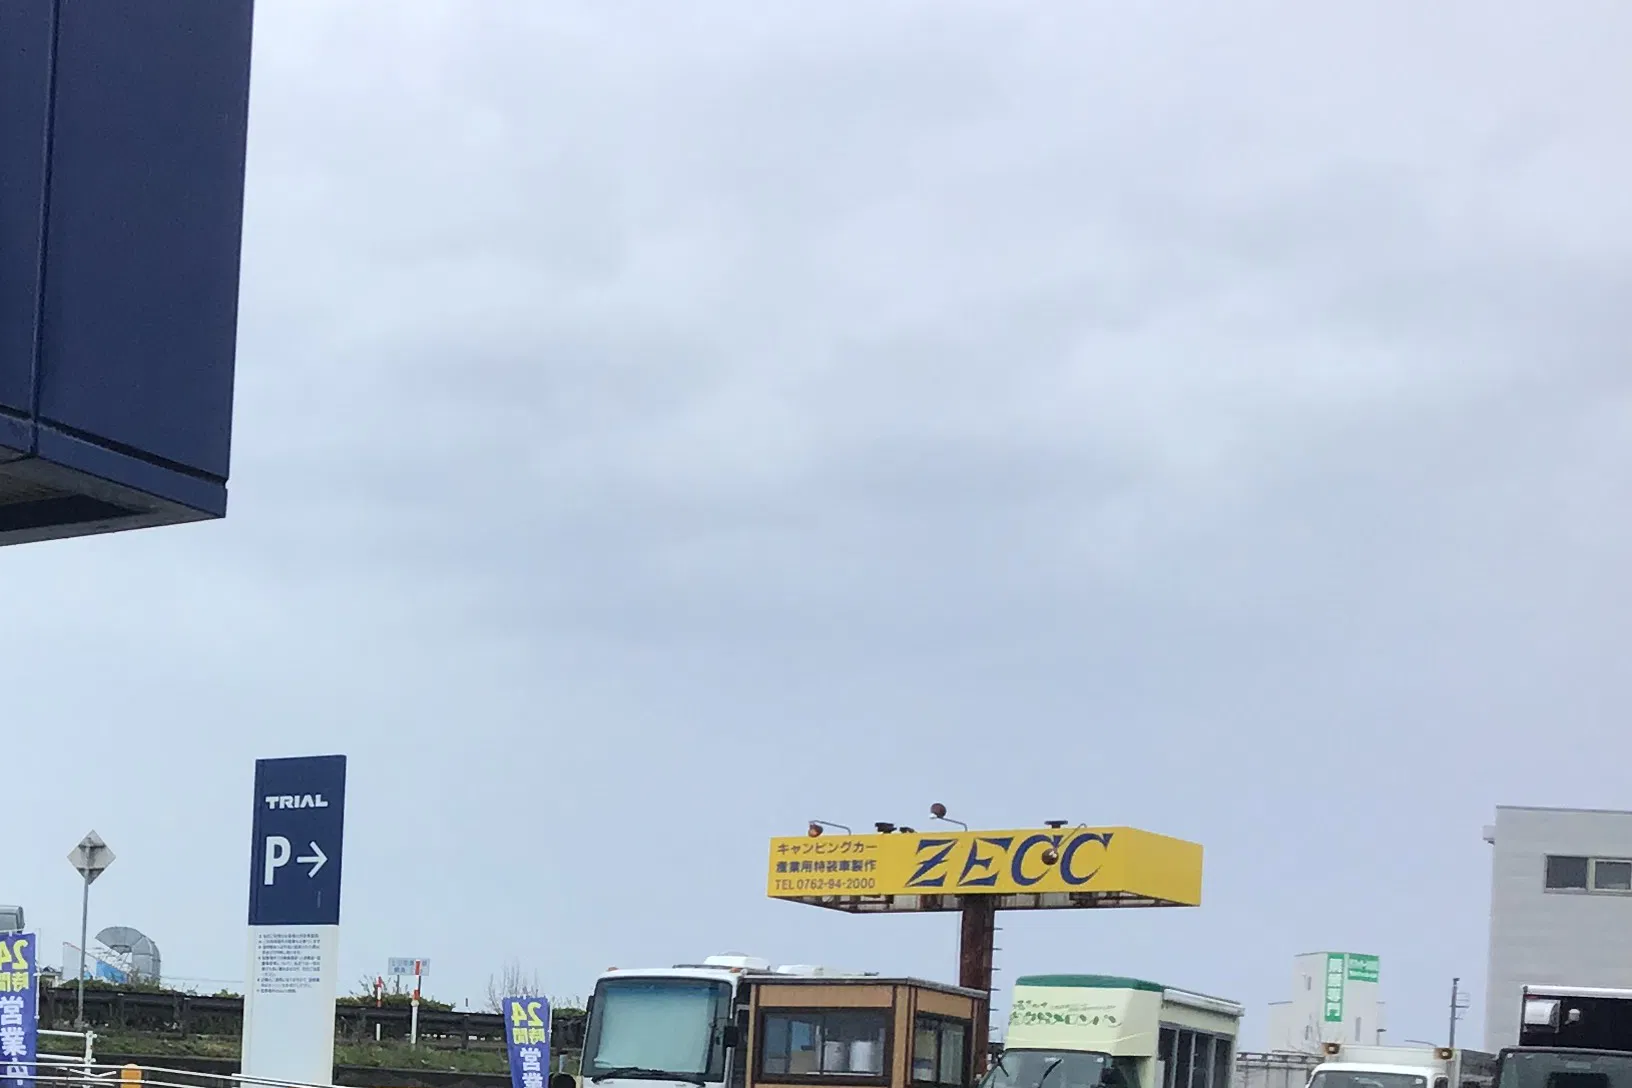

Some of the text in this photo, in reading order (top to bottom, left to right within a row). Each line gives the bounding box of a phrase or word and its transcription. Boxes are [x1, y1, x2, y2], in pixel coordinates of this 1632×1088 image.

[265, 794, 328, 809] TRIAL
[264, 836, 291, 885] P
[904, 832, 1114, 888] ZECC
[775, 878, 794, 890] TEL
